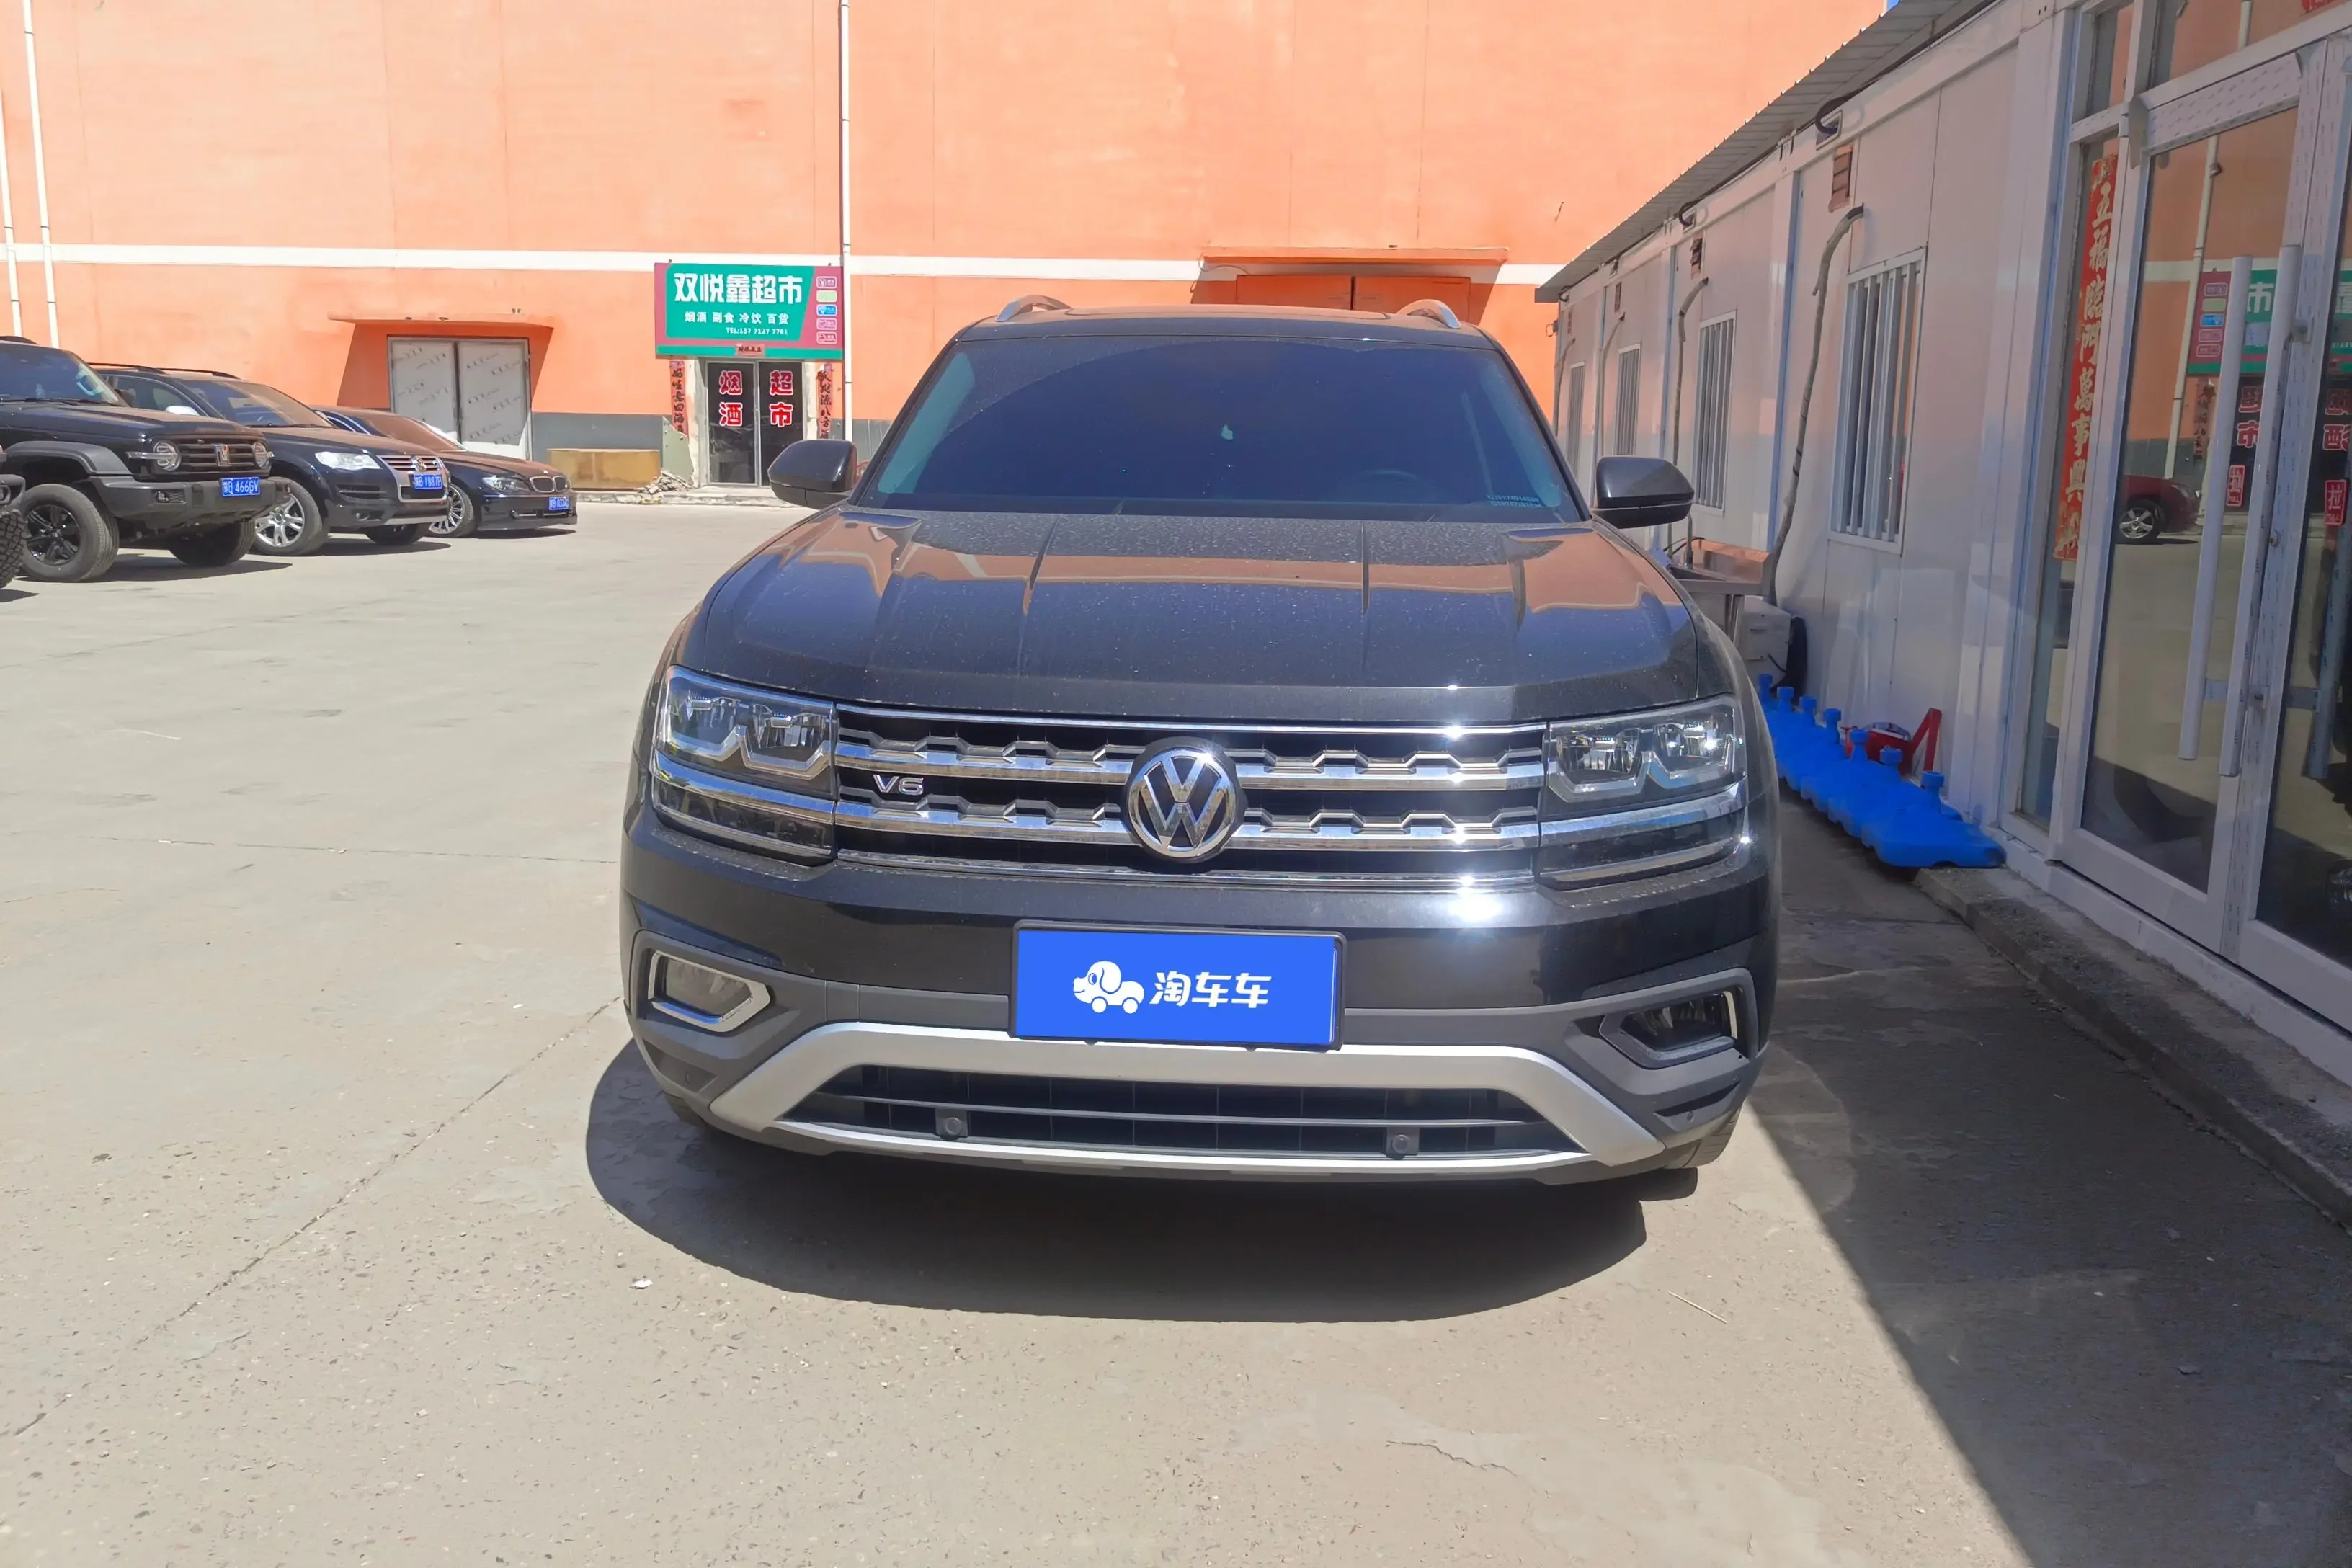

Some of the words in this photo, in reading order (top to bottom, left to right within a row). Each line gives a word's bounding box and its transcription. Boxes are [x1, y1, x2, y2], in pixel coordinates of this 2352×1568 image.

[674, 272, 803, 304] 双悦鑫超市
[685, 311, 707, 323] 烟酒
[712, 312, 735, 324] 副食
[739, 313, 762, 324] 冷饮
[767, 313, 790, 324] 百货
[769, 370, 794, 427] 超市
[873, 774, 924, 796] V6
